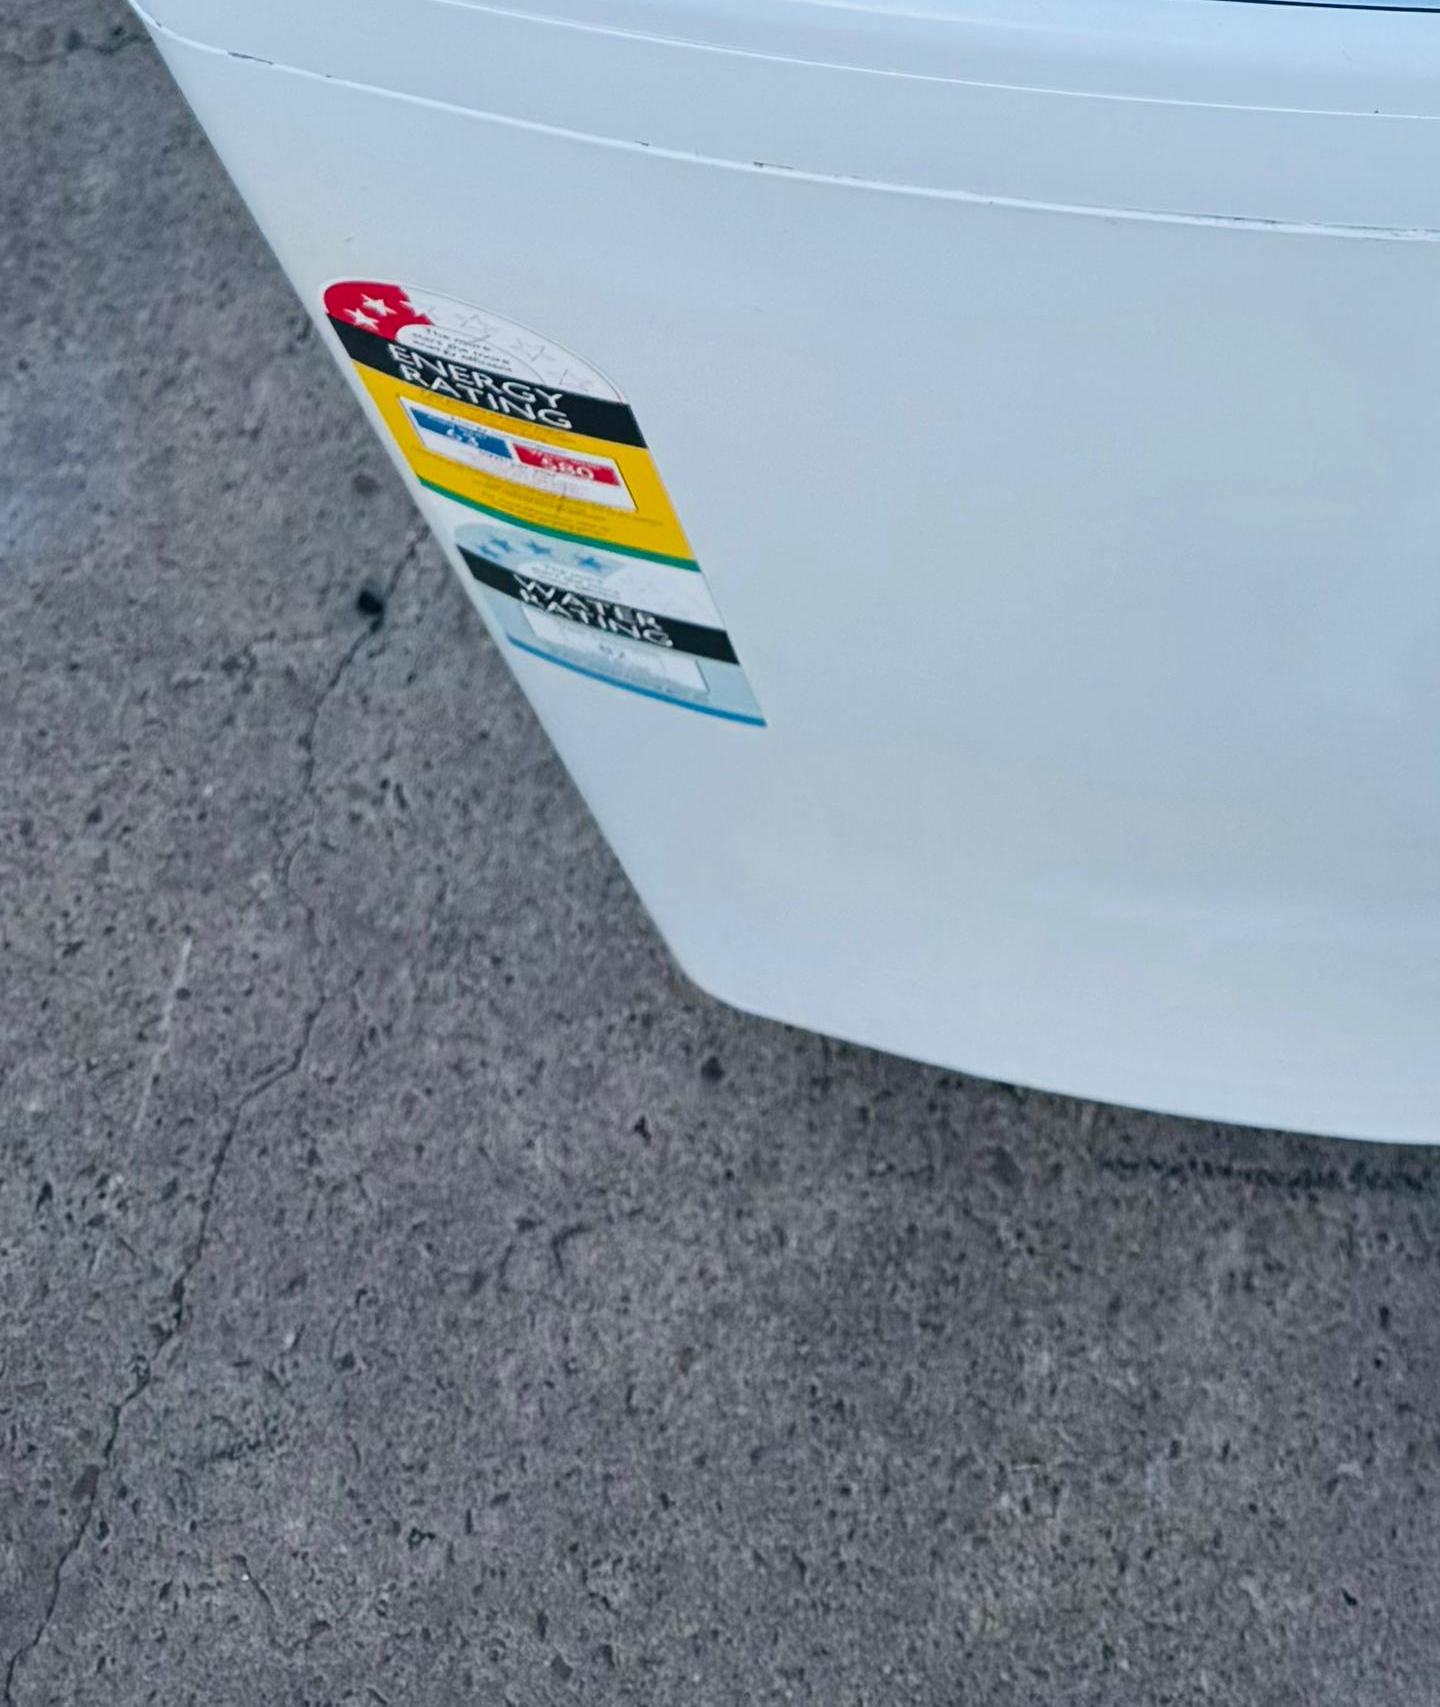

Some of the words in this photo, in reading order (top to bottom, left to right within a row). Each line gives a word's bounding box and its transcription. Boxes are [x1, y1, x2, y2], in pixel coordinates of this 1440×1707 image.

[388, 343, 563, 408] ENERGY
[400, 364, 573, 429] RATING
[513, 573, 663, 632] WATER
[520, 587, 674, 648] RATING
